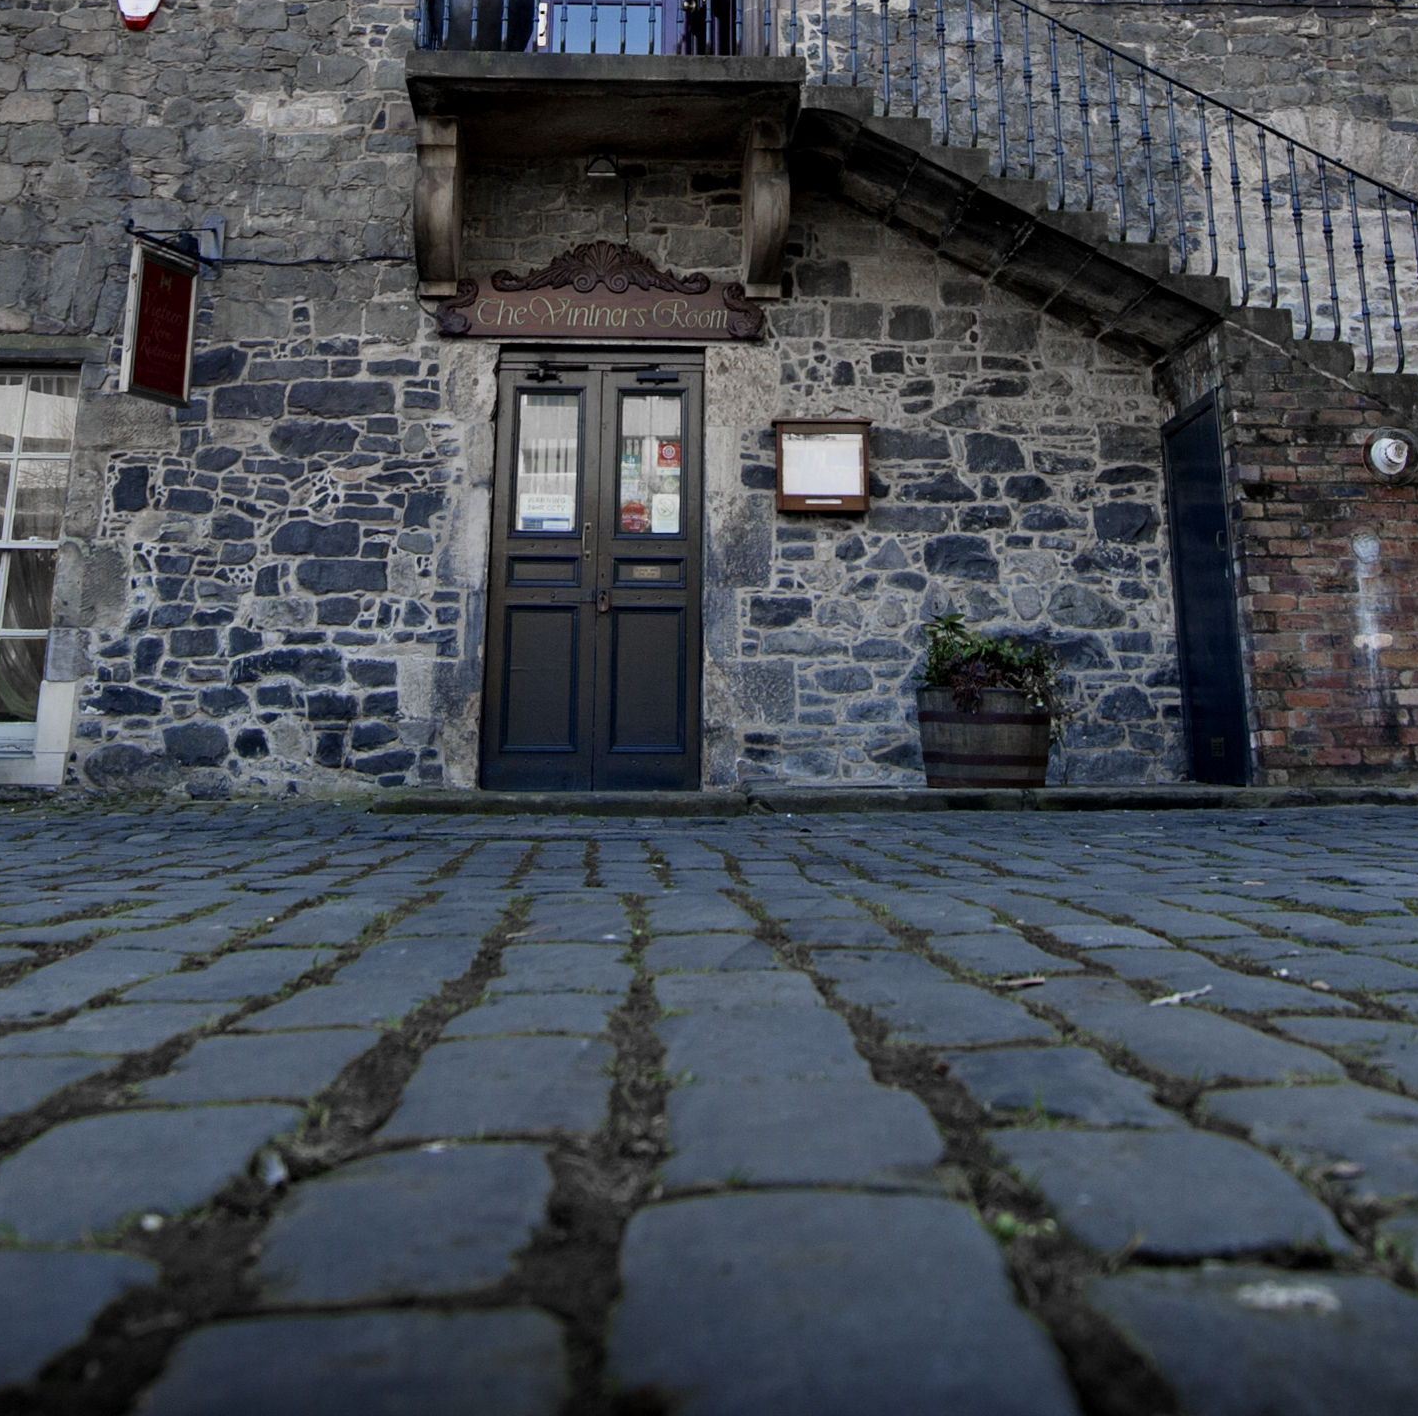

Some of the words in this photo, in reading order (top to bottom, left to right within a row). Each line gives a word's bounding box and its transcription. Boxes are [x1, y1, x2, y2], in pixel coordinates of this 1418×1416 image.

[475, 297, 528, 327] The
[529, 295, 648, 328] Vintners
[652, 298, 729, 329] Room
[527, 496, 566, 504] WARNING
